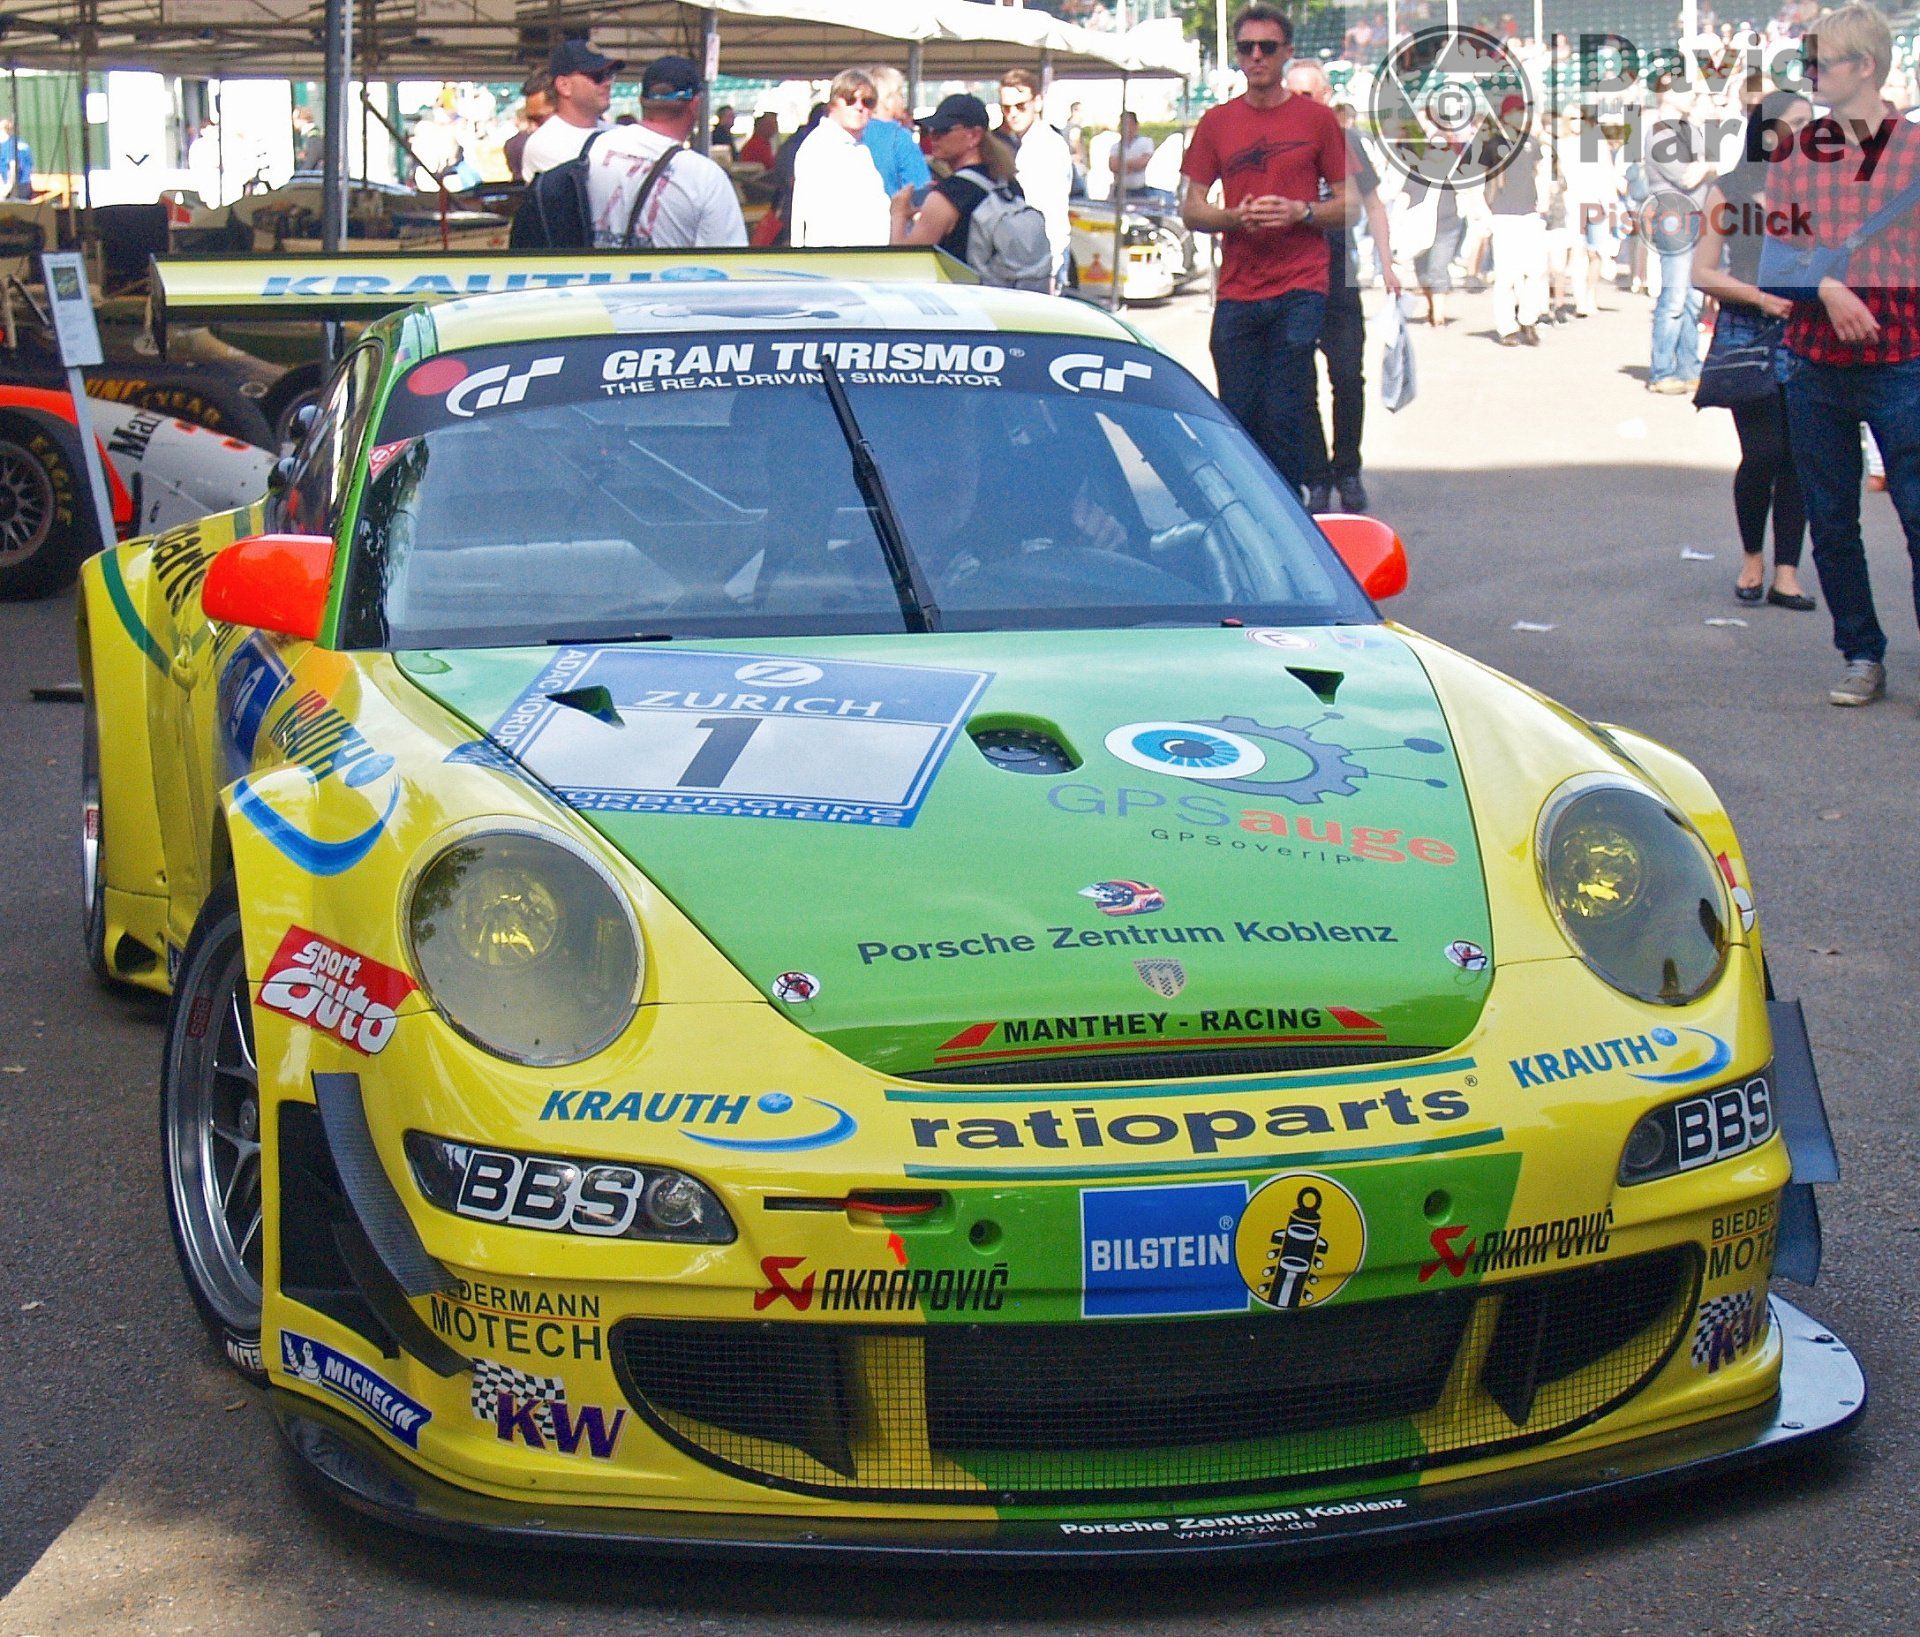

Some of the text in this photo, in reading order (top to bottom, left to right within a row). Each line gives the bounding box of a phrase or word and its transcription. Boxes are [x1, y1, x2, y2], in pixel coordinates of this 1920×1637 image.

[600, 372, 1001, 396] THE REAL DRIVIN SIMULATOR
[602, 342, 1005, 380] GRAN TURISMO
[538, 649, 588, 690] ADAC
[636, 690, 883, 717] ZURICH
[676, 717, 764, 788] 1
[291, 940, 362, 985] sport
[857, 920, 1399, 966] Porsche Zentrum Koblenz
[261, 966, 398, 1053] auto
[1003, 1011, 1169, 1044] MANTHEY
[1200, 1007, 1322, 1035] RACING
[1508, 1035, 1659, 1089] KRAUTH
[539, 1090, 751, 1125] KRAUTH
[910, 1086, 1471, 1154] ratioparts
[1675, 1077, 1773, 1171] BBS
[456, 1149, 644, 1237] BBS
[1091, 1232, 1230, 1272] BILSTEIN
[430, 1296, 602, 1361] MOTECH
[324, 1356, 420, 1431] MICHELIN
[497, 1392, 628, 1459] KW
[1060, 1498, 1407, 1535] Porsche Zentrum Koblenz
